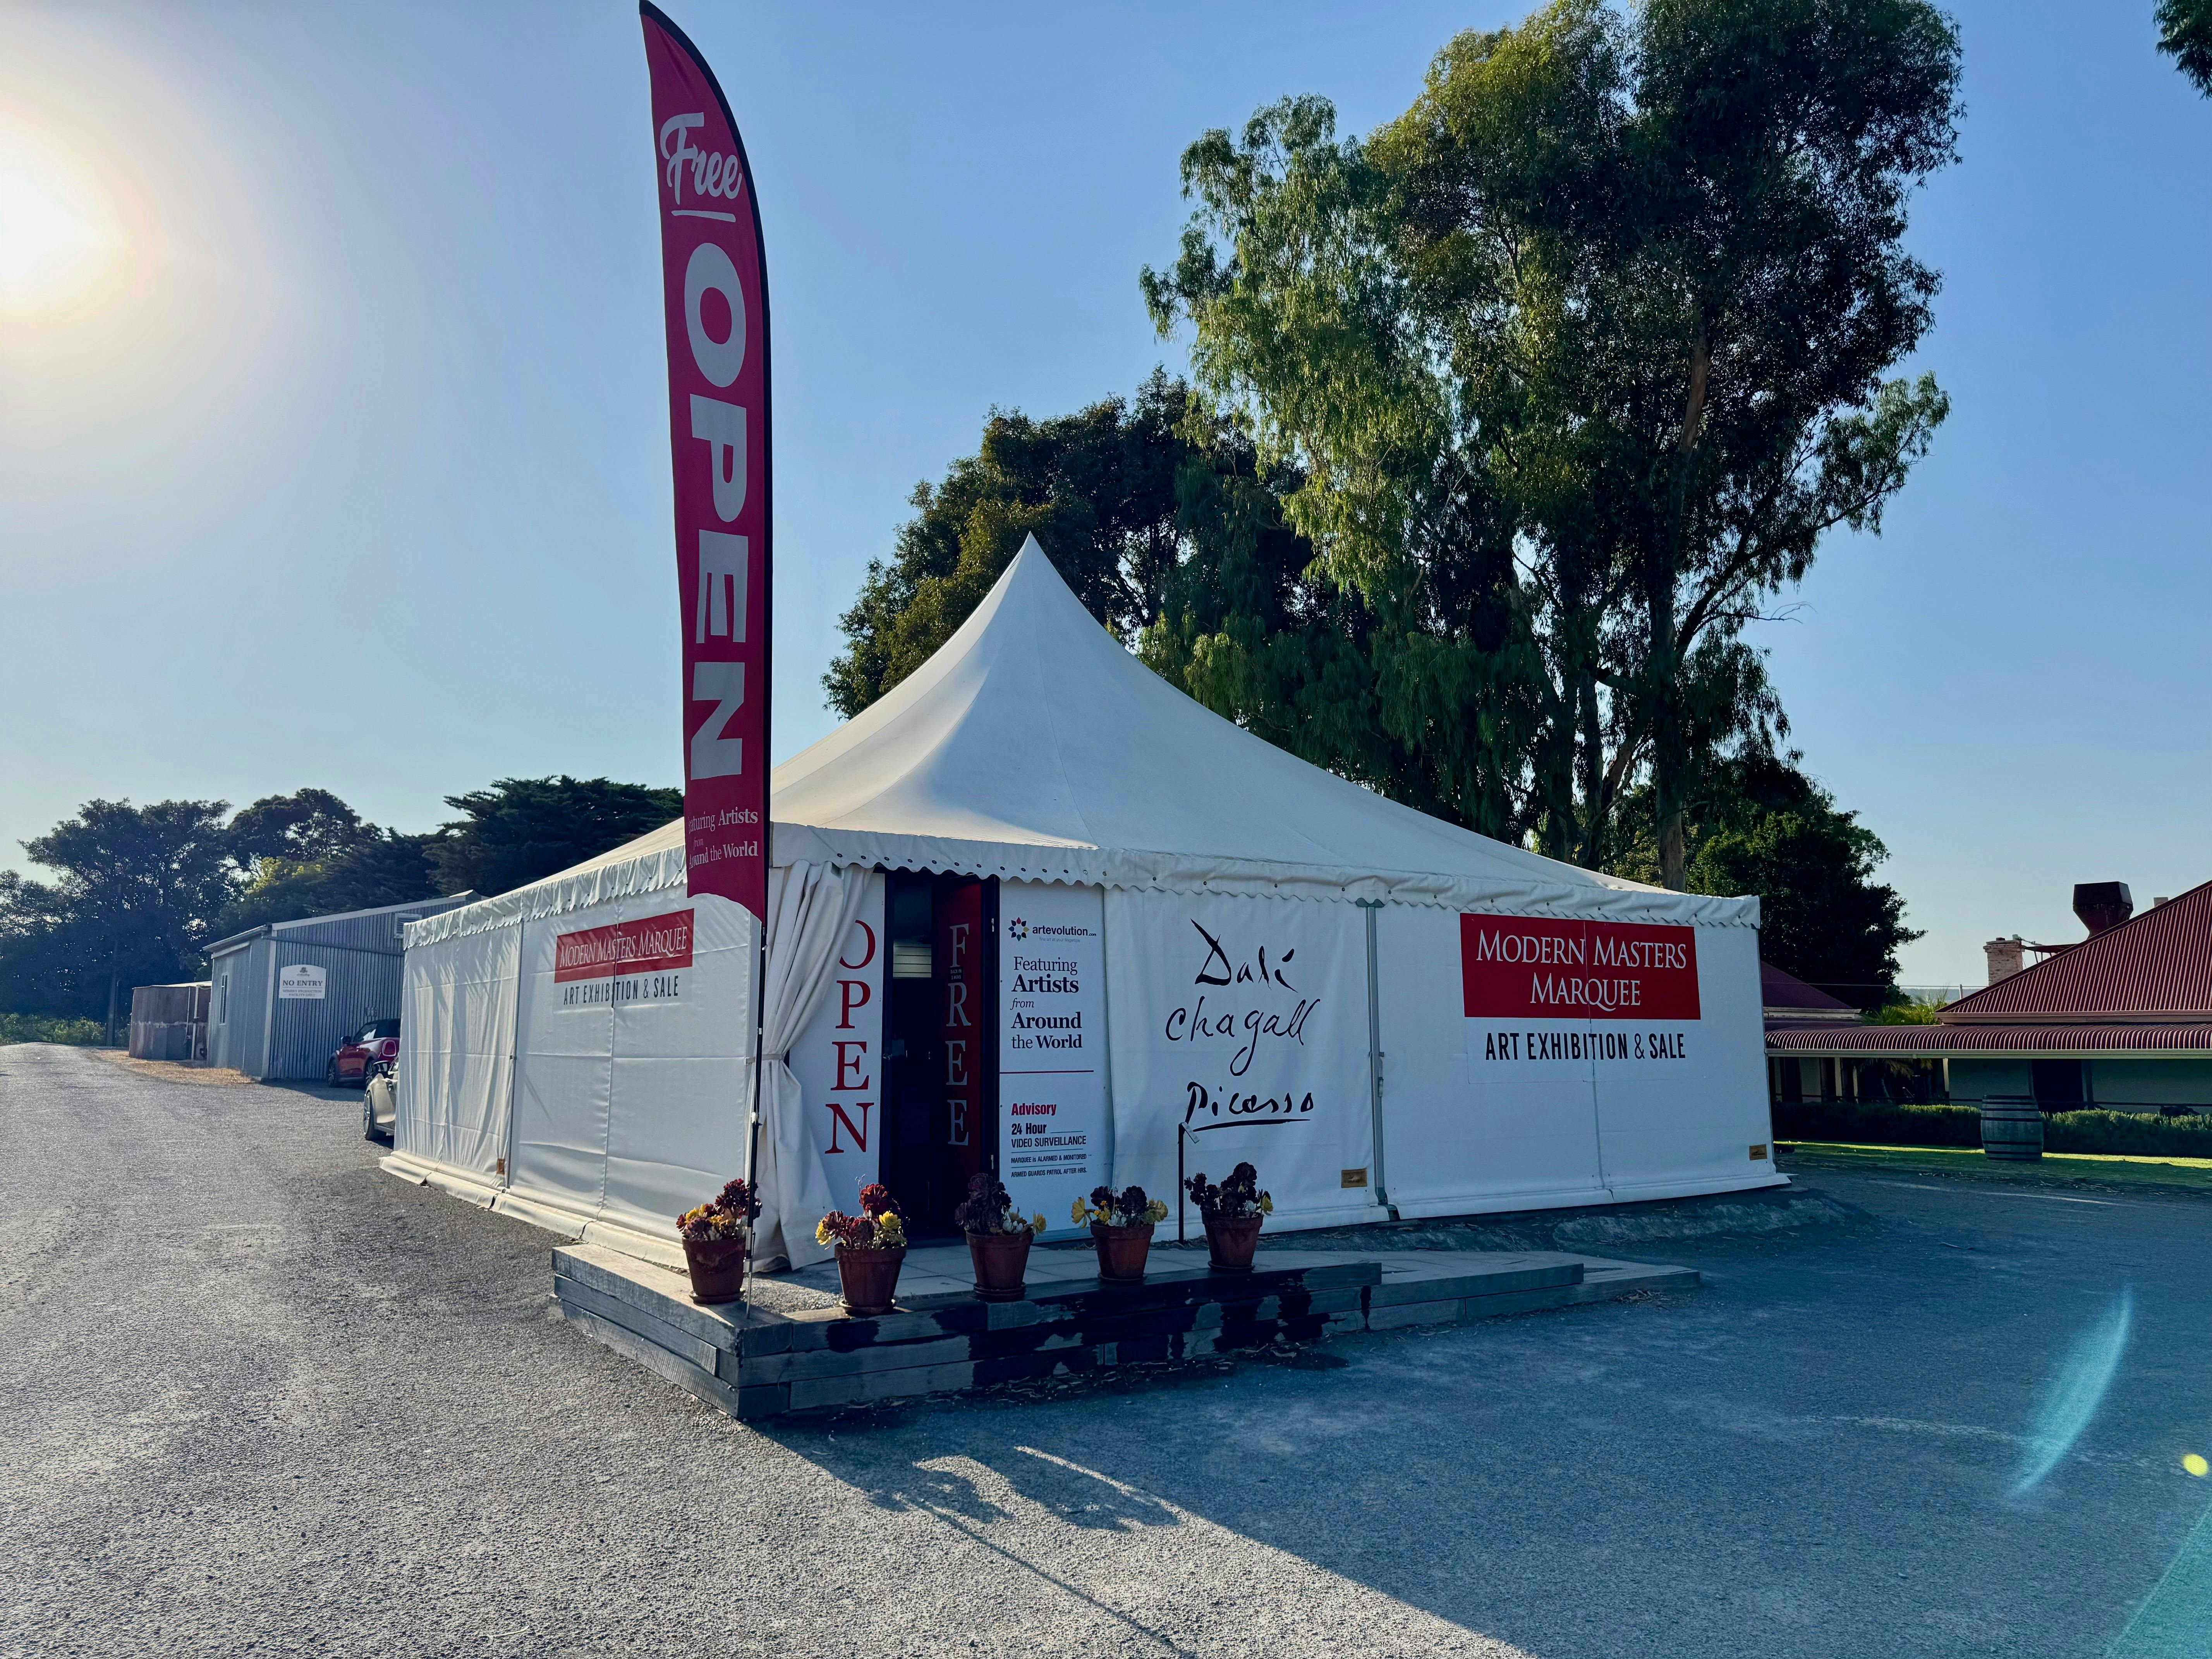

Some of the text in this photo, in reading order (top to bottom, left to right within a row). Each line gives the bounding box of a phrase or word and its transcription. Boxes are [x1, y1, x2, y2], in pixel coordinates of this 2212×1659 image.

[660, 112, 742, 205] Free
[684, 242, 749, 780] OPEN
[689, 807, 758, 832] aturing Artists
[711, 846, 722, 861] the
[723, 841, 758, 858] World
[559, 926, 688, 967] MODERN MASTERS MARQUEE
[1476, 929, 1686, 969] MODERN MASTERS
[1013, 956, 1078, 975] Featuring
[564, 975, 679, 1005] ART EXHIBITION & SALE
[1011, 973, 1079, 993] Artists
[1530, 972, 1640, 1012] MARQUEE
[1010, 998, 1034, 1010] from
[1010, 1012, 1082, 1029] Around
[946, 923, 971, 1146] FREE
[1011, 1034, 1083, 1049] the World
[1486, 1032, 1686, 1060] ART EXHIBITION & SALE
[1011, 1103, 1057, 1116] Advisory
[1185, 1081, 1314, 1124] Picasso
[1011, 1123, 1047, 1135] 24 Hour
[1011, 1135, 1086, 1148] VIDEO SURVEILLANCE
